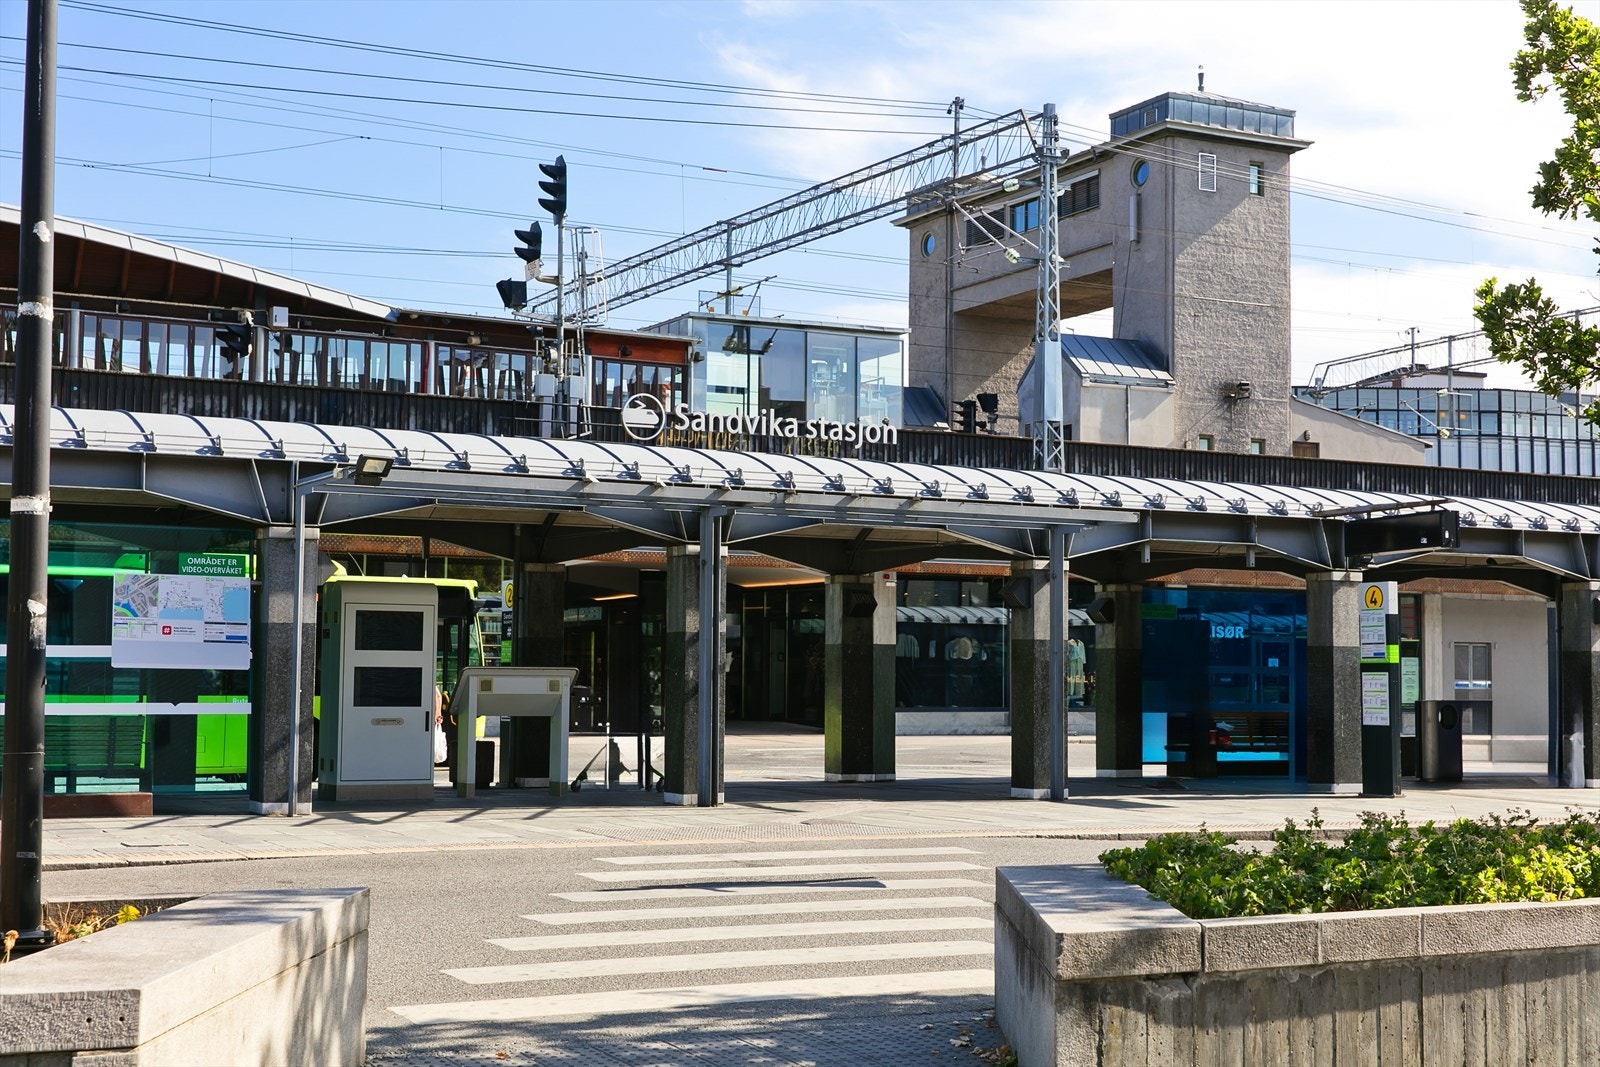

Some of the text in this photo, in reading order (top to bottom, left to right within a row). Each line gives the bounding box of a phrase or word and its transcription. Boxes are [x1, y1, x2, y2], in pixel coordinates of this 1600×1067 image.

[674, 402, 799, 438] Sandvika
[806, 417, 898, 449] stasjon
[187, 557, 237, 566] OMRÅDET ER
[181, 566, 242, 574] VIDEO-OVERVÅKET
[1370, 590, 1378, 606] 4
